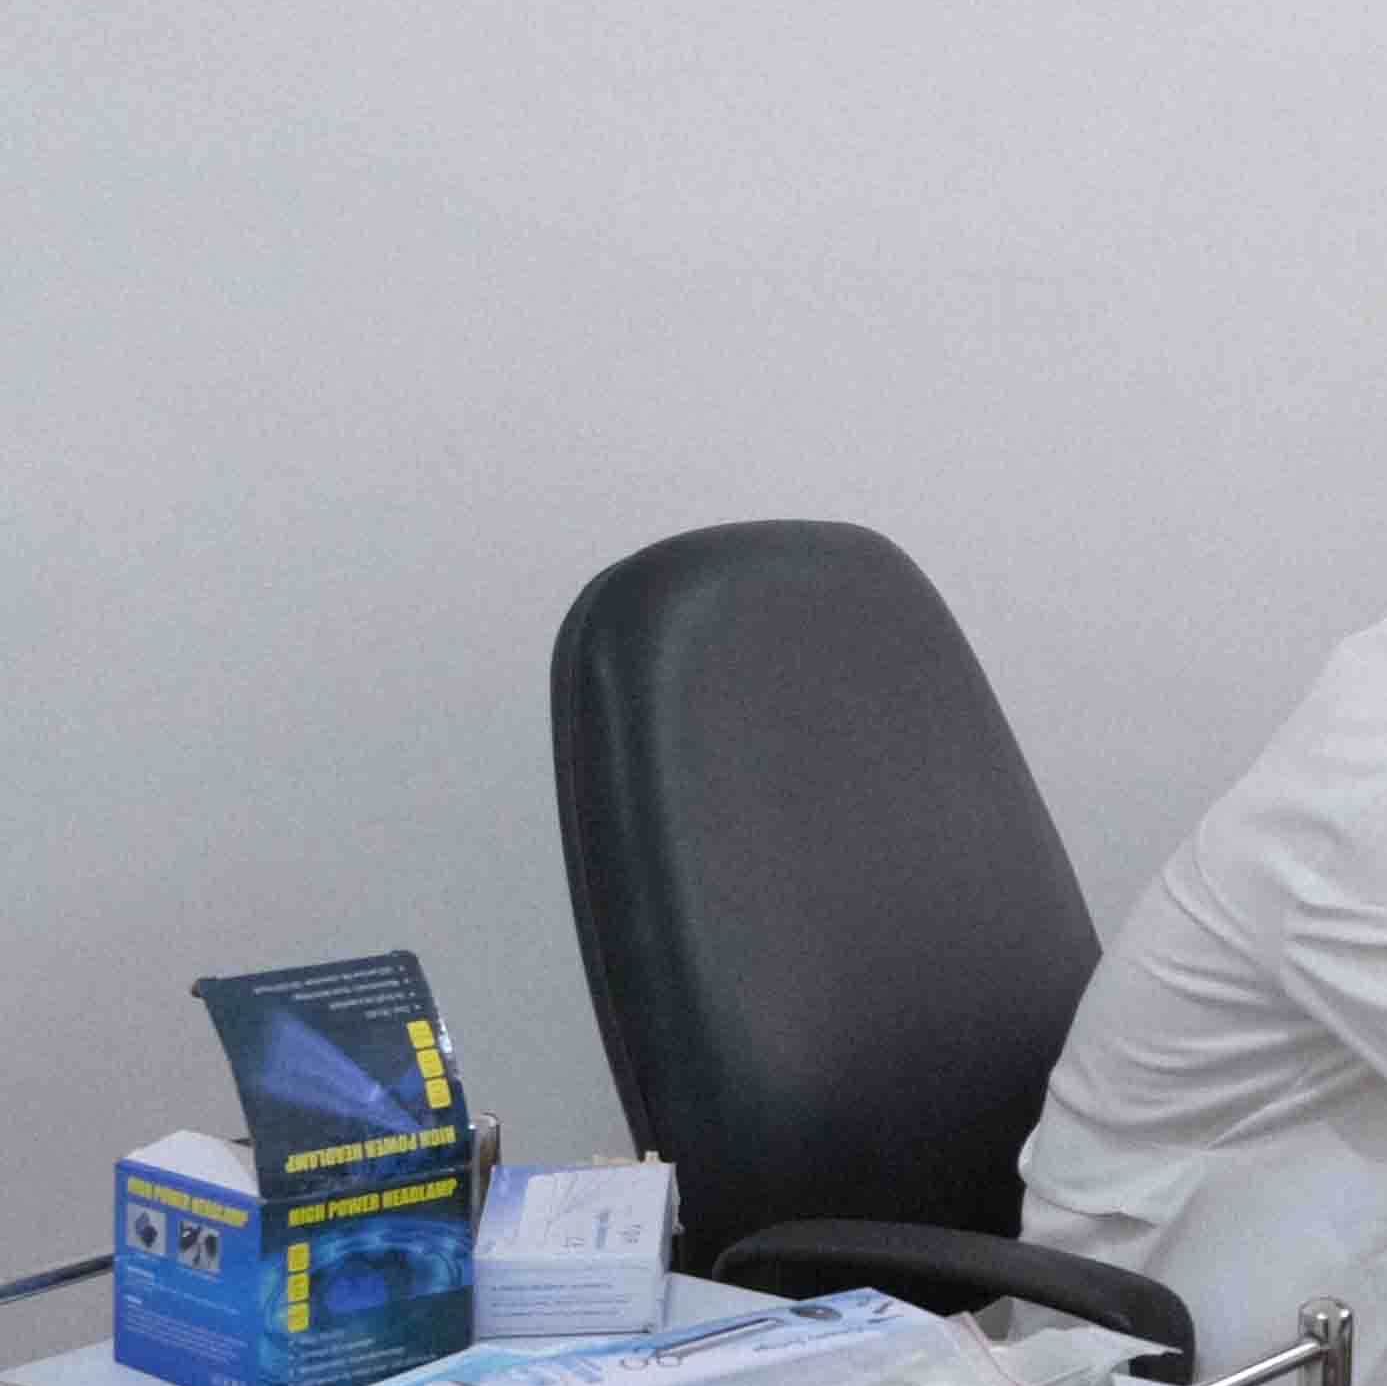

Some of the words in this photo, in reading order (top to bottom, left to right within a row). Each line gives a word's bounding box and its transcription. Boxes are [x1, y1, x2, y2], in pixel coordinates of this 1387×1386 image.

[288, 1203, 326, 1227] HIGH
[328, 1192, 380, 1219] POWER
[382, 1177, 459, 1207] HEADLAMP
